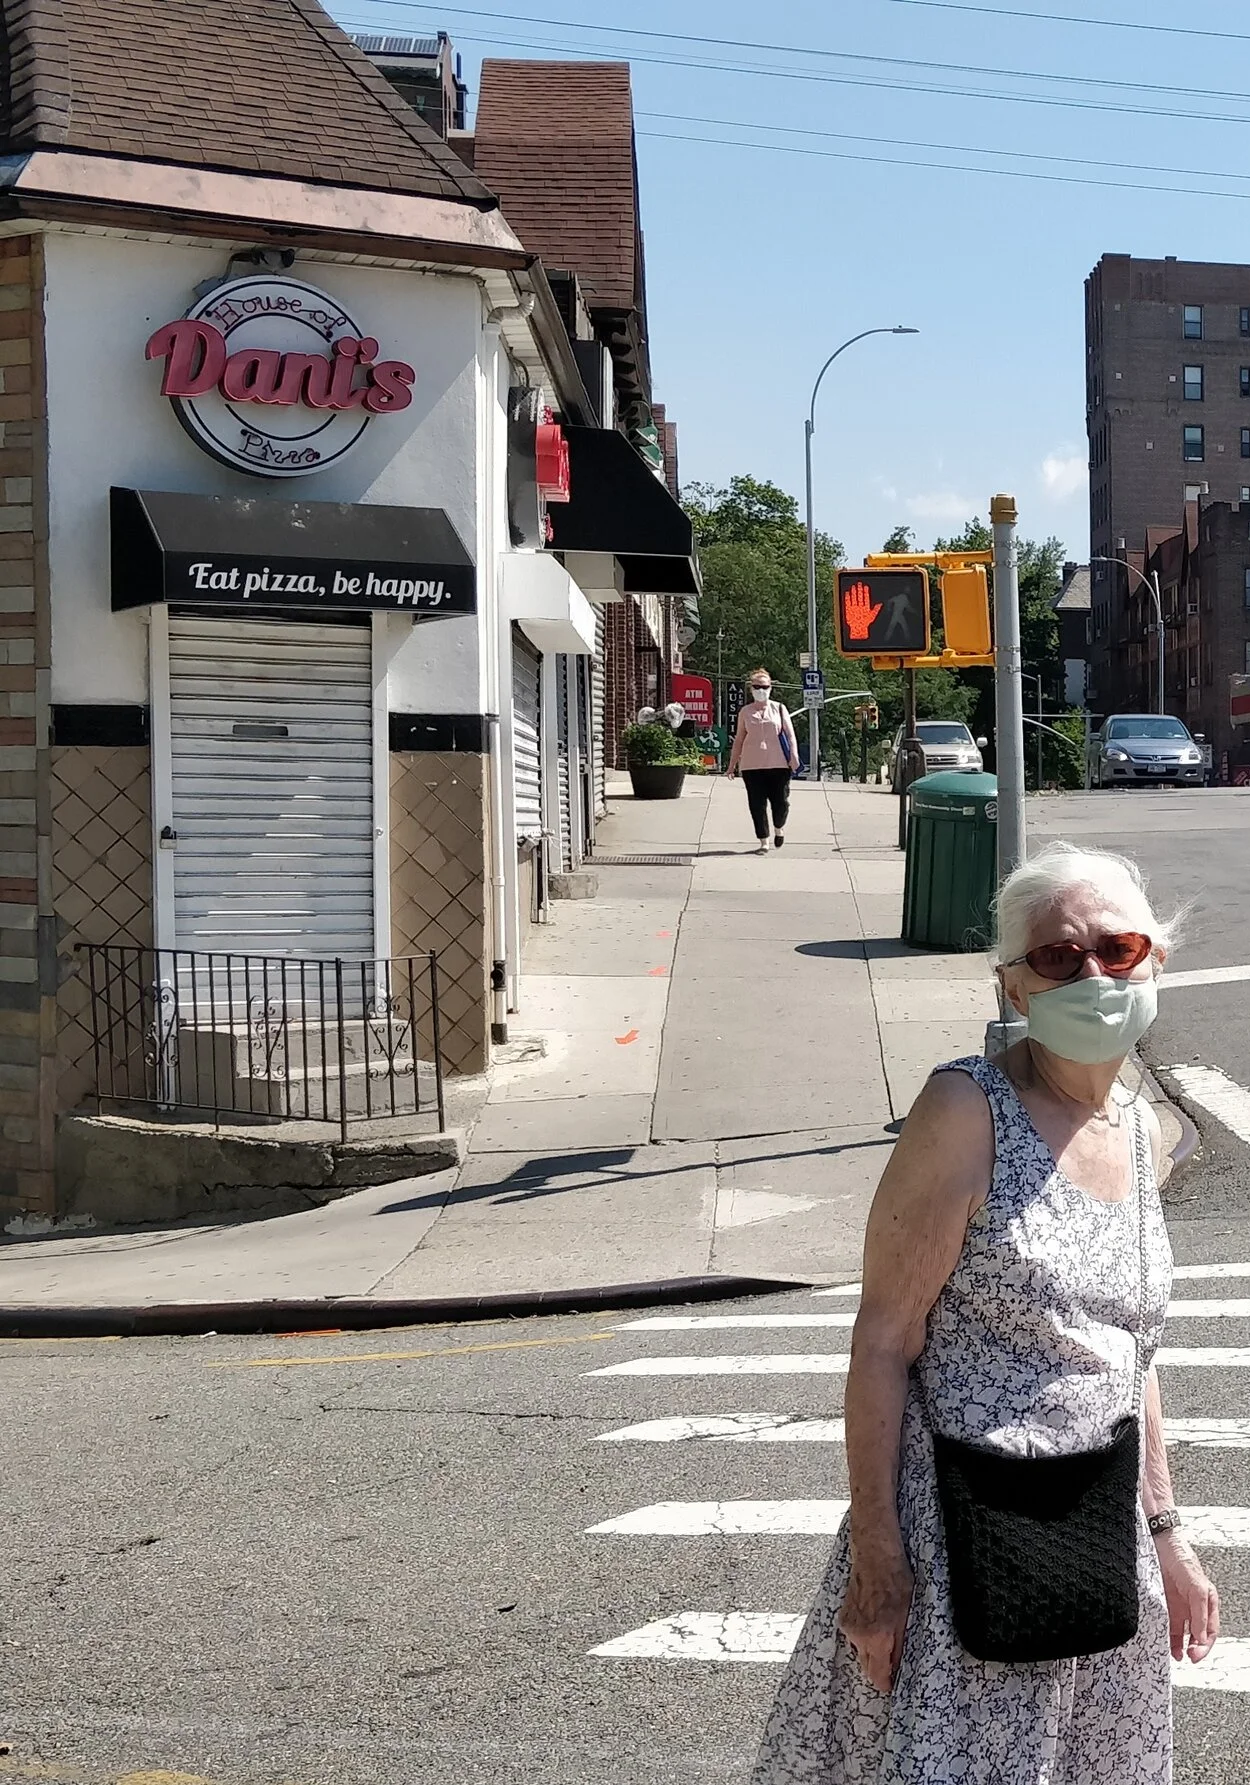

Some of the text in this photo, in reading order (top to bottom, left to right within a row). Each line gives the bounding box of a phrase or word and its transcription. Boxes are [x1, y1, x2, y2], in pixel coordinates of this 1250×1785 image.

[205, 295, 347, 340] House of
[145, 318, 416, 414] Dani's
[238, 429, 321, 464] Pizza
[188, 562, 452, 605] Eat pizza, be happy.
[685, 690, 703, 698] ATM
